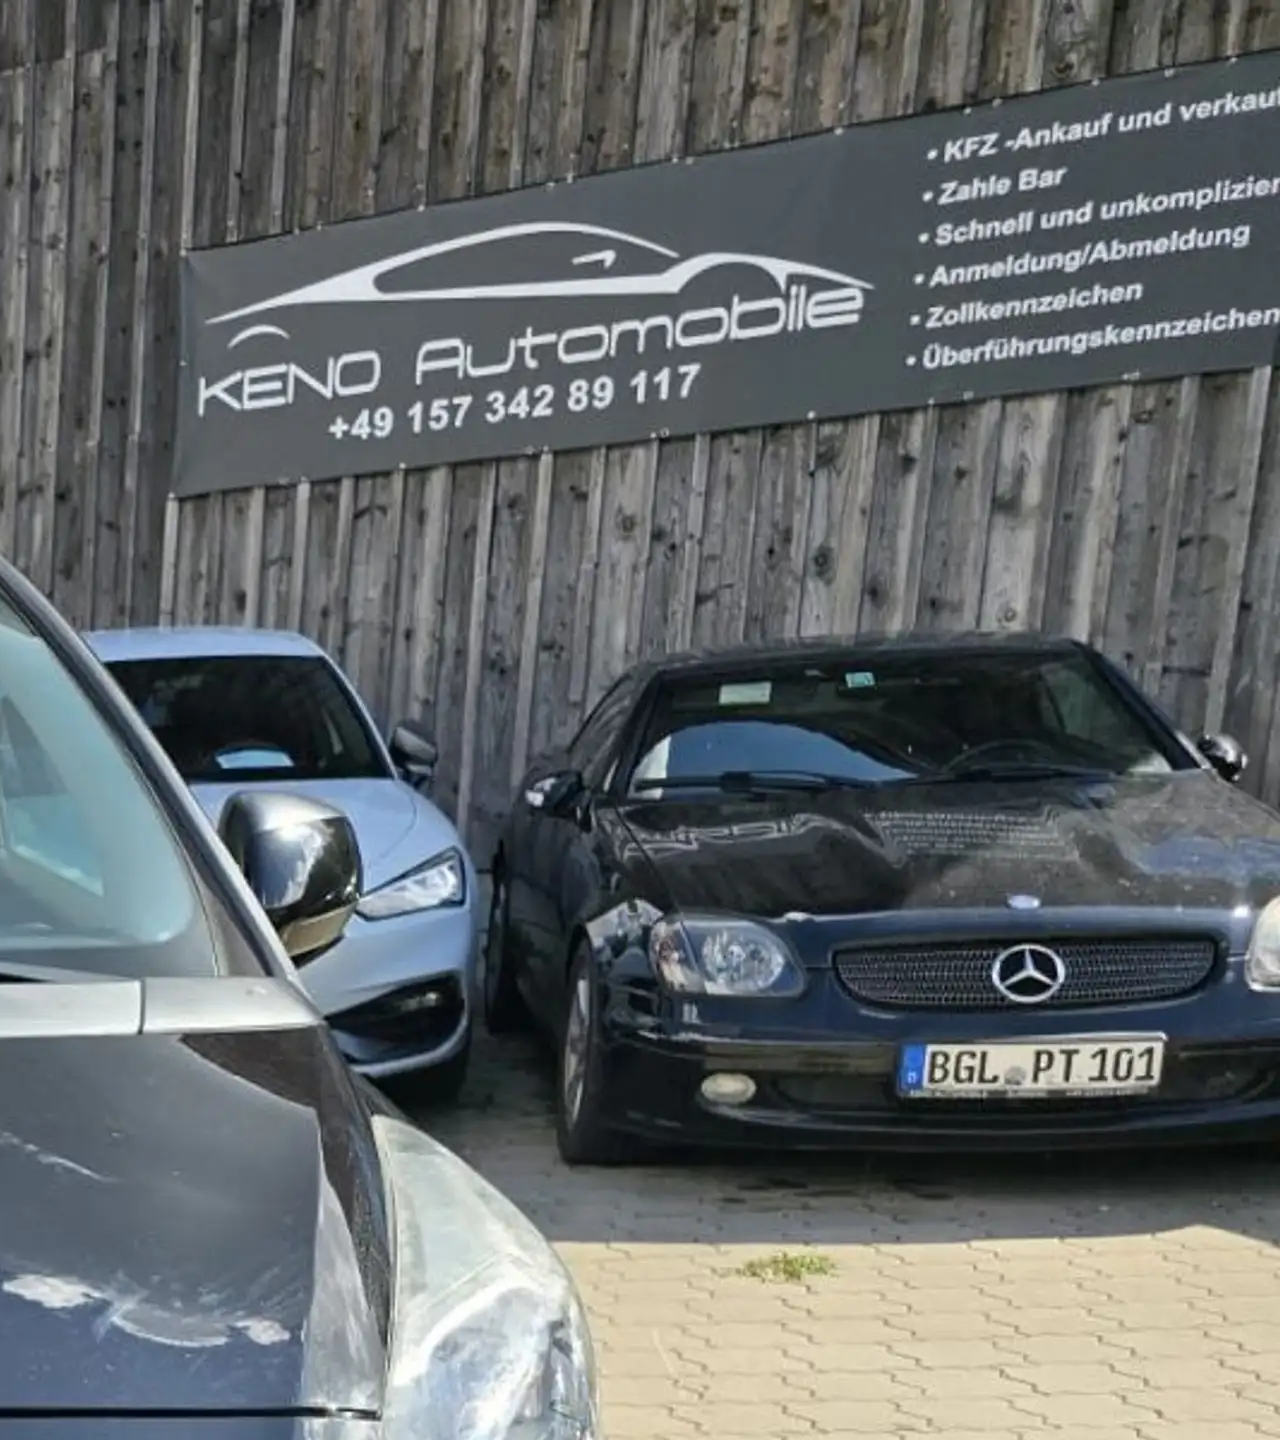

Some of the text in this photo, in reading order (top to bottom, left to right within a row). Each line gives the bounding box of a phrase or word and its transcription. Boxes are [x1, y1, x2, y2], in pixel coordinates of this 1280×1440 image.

[943, 132, 1000, 162] KFZ
[1118, 103, 1171, 133] und
[1179, 86, 1280, 122] verkau
[938, 166, 1068, 205] Zahle Bar
[935, 213, 1034, 246] Schnell
[1040, 202, 1093, 231] und
[929, 224, 1251, 287] Anmeldung/Abmeldung
[925, 282, 1143, 329] Zollkennzeichen
[197, 285, 867, 418] KENO Automobile
[922, 307, 1280, 369] Überführungskennzeichen
[329, 364, 701, 440] +49 157 342 89 117
[928, 1046, 1155, 1084] BGL PT 101
